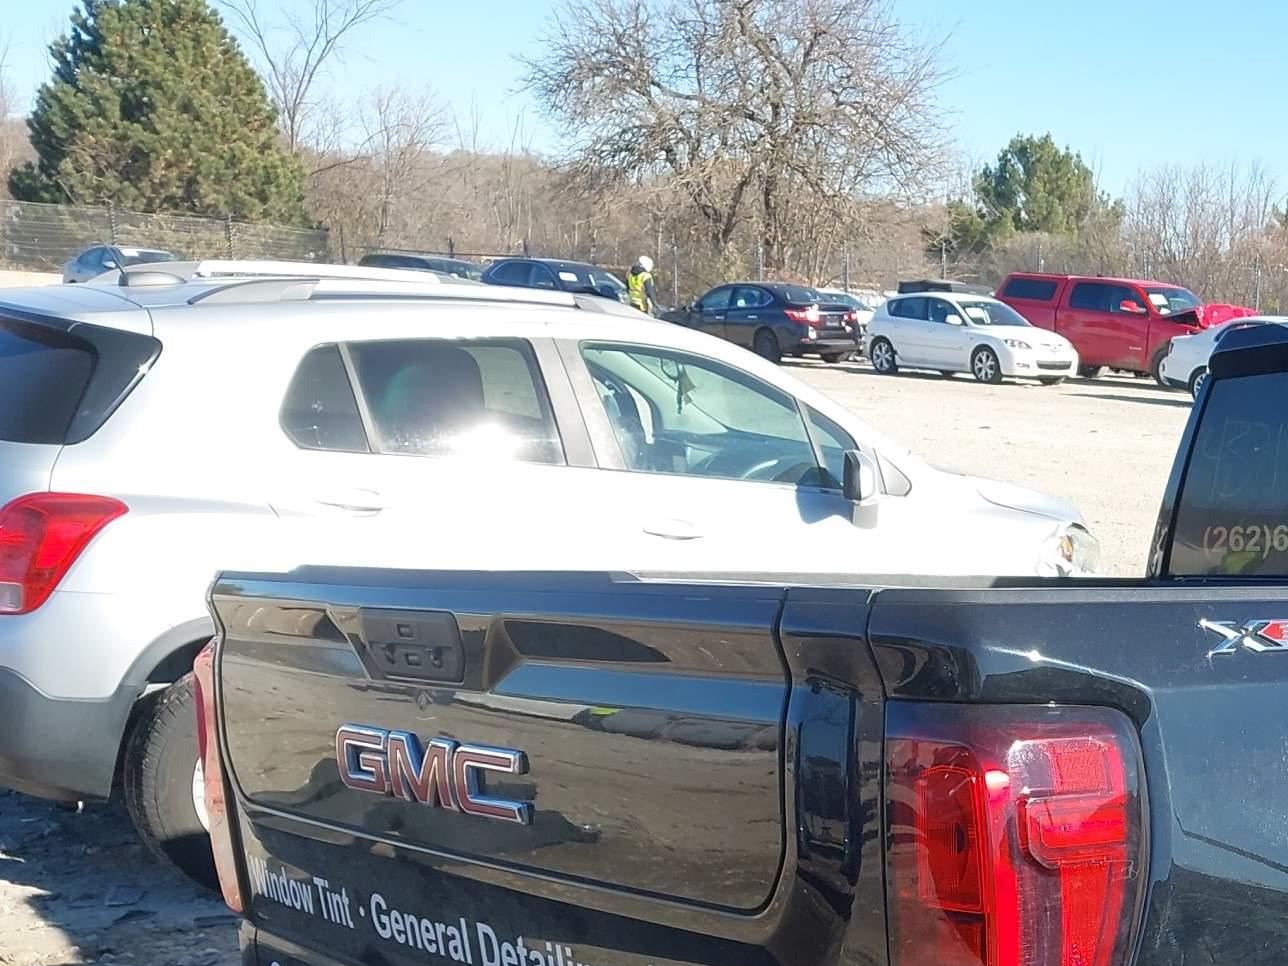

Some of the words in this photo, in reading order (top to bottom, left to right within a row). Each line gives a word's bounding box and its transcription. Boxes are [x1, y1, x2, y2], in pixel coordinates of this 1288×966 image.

[335, 724, 535, 825] GMC
[250, 854, 314, 915] Window
[313, 876, 354, 928] Tint
[371, 892, 473, 965] General
